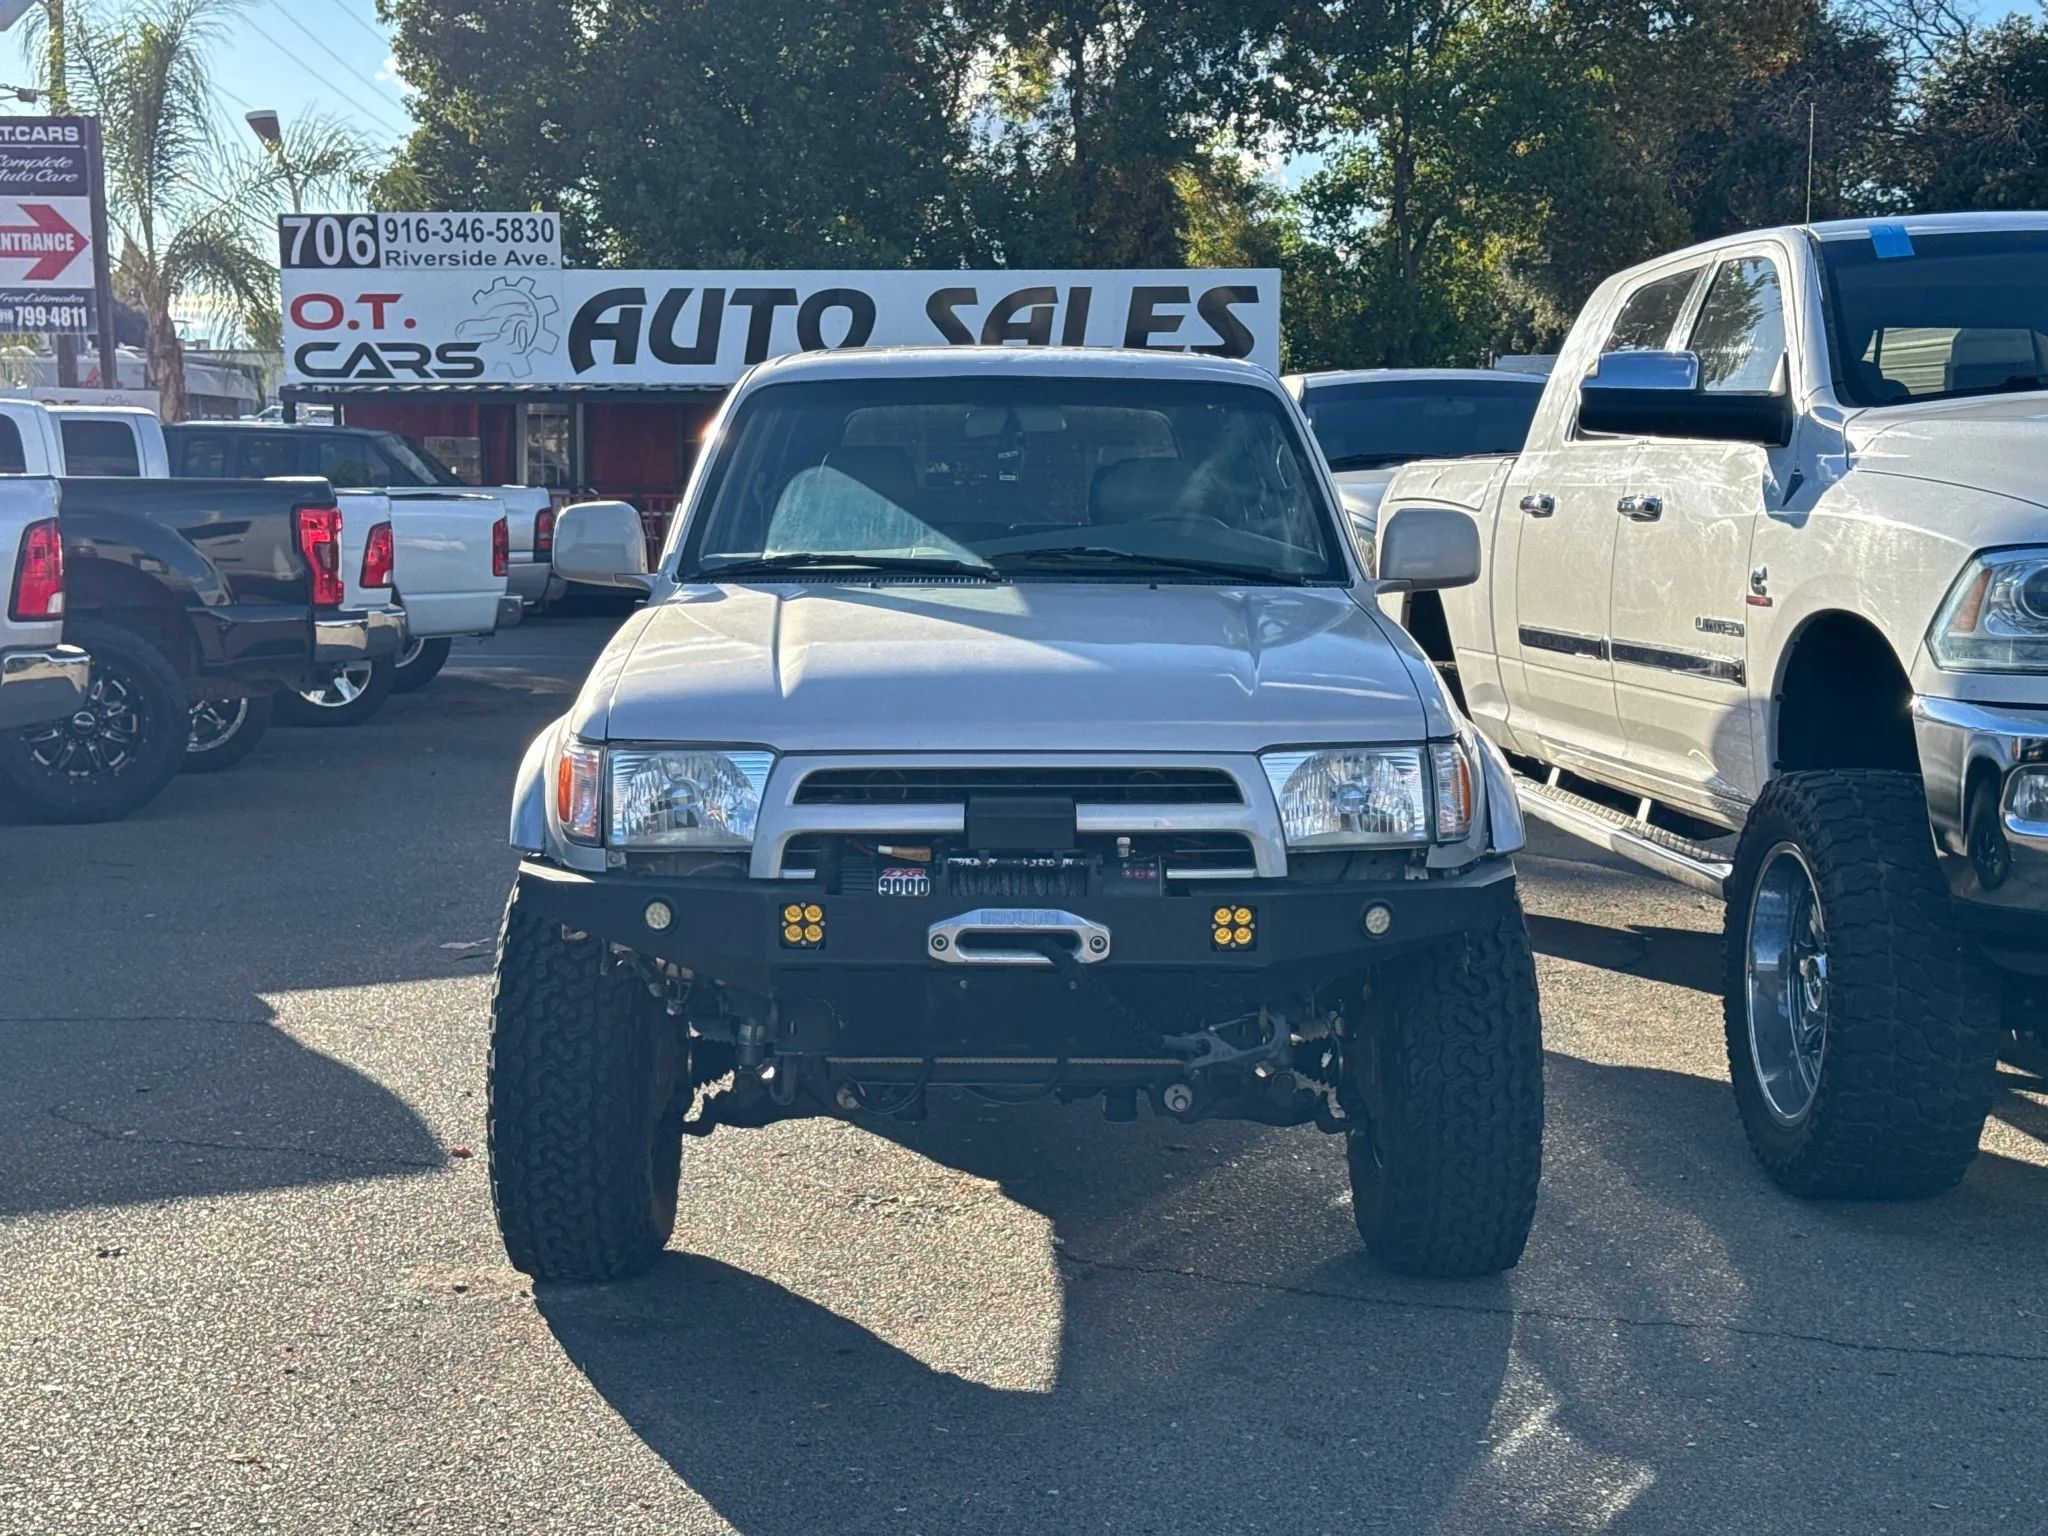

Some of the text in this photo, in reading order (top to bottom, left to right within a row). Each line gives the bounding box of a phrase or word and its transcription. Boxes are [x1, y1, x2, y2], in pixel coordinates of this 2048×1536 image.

[0, 126, 79, 142] .T.CARS
[35, 169, 79, 182] Care
[282, 216, 377, 266] 706
[384, 217, 555, 244] 916-346-5830
[0, 232, 76, 252] NTRANCE
[385, 249, 556, 267] Riverside Ave.
[15, 305, 88, 328] 799-4811
[290, 293, 417, 331] O.T.
[568, 284, 1260, 375] AUTO SALES
[294, 342, 485, 379] CARS
[882, 867, 926, 878] ZXR
[879, 877, 930, 897] 9000
